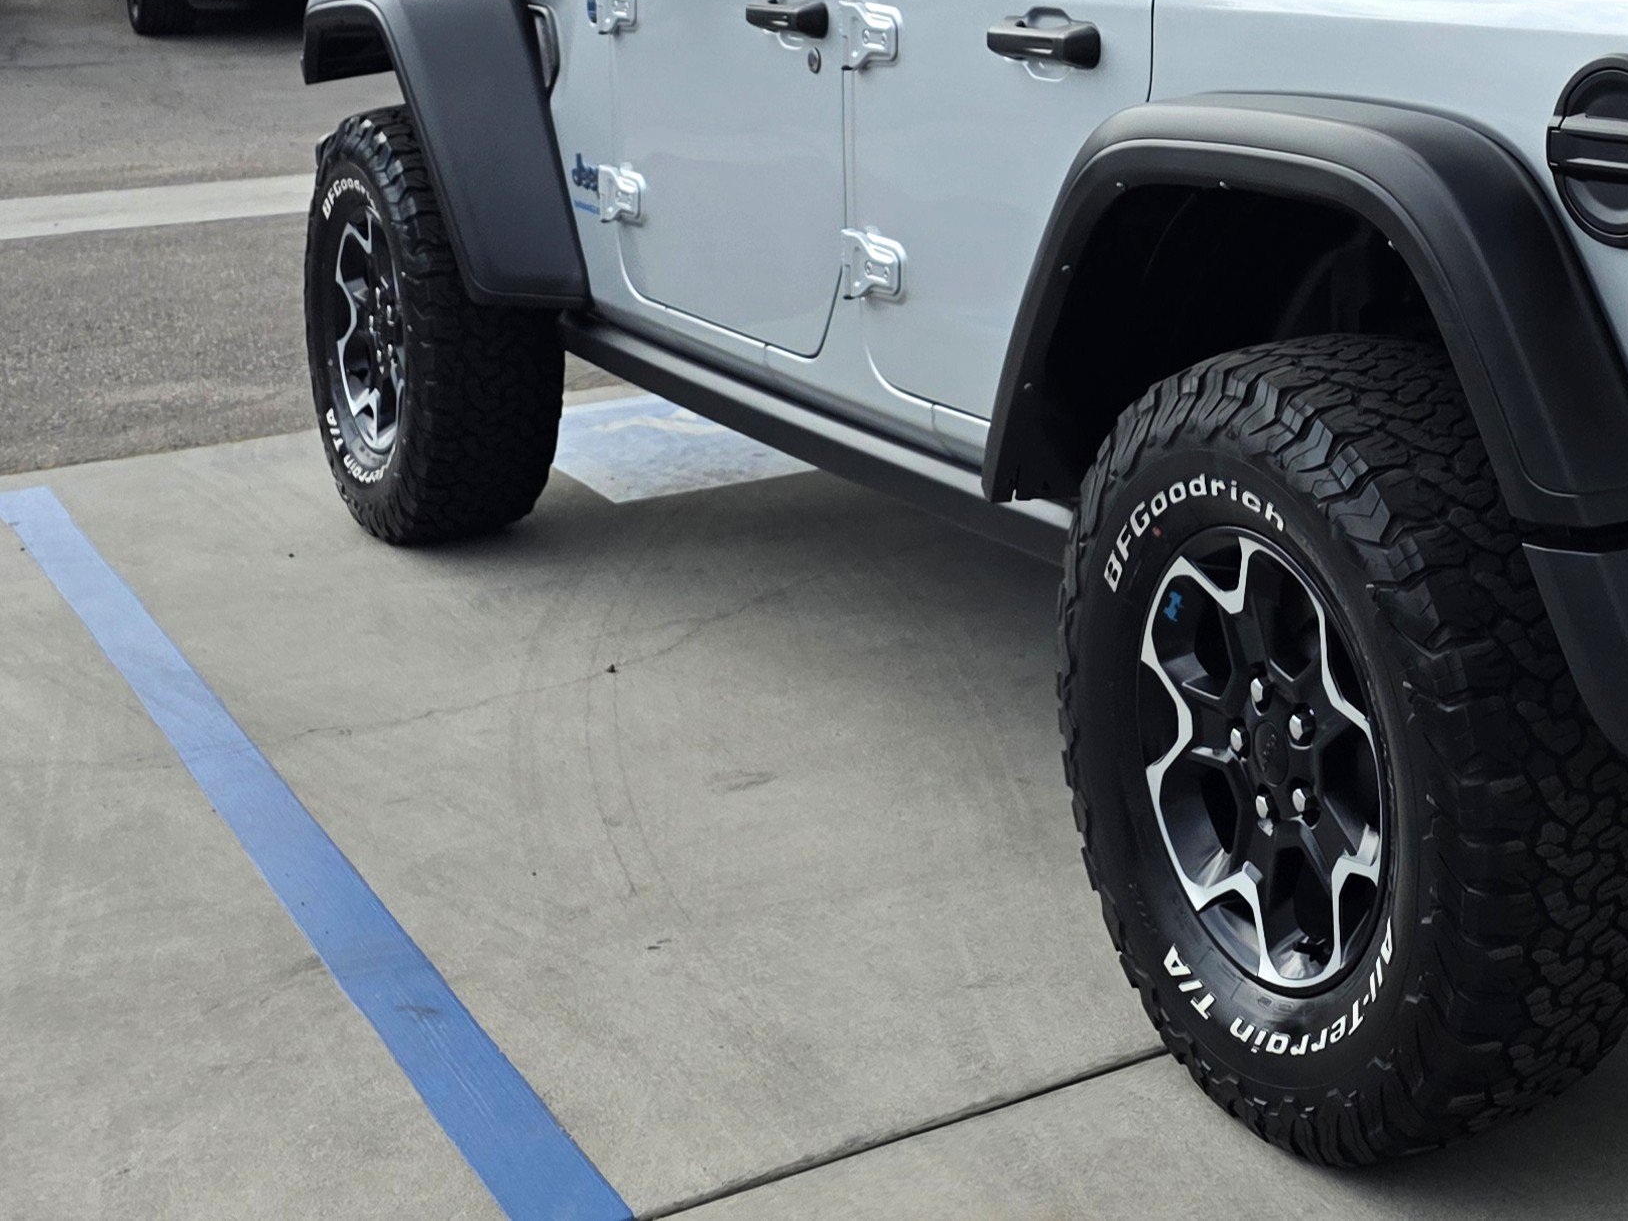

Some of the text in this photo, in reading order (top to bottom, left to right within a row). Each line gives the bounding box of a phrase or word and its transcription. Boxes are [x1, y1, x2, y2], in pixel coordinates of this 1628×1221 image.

[571, 153, 599, 191] Jee
[1103, 472, 1286, 593] BFGoodrich
[1163, 917, 1397, 1057] All-Terrain T/A
